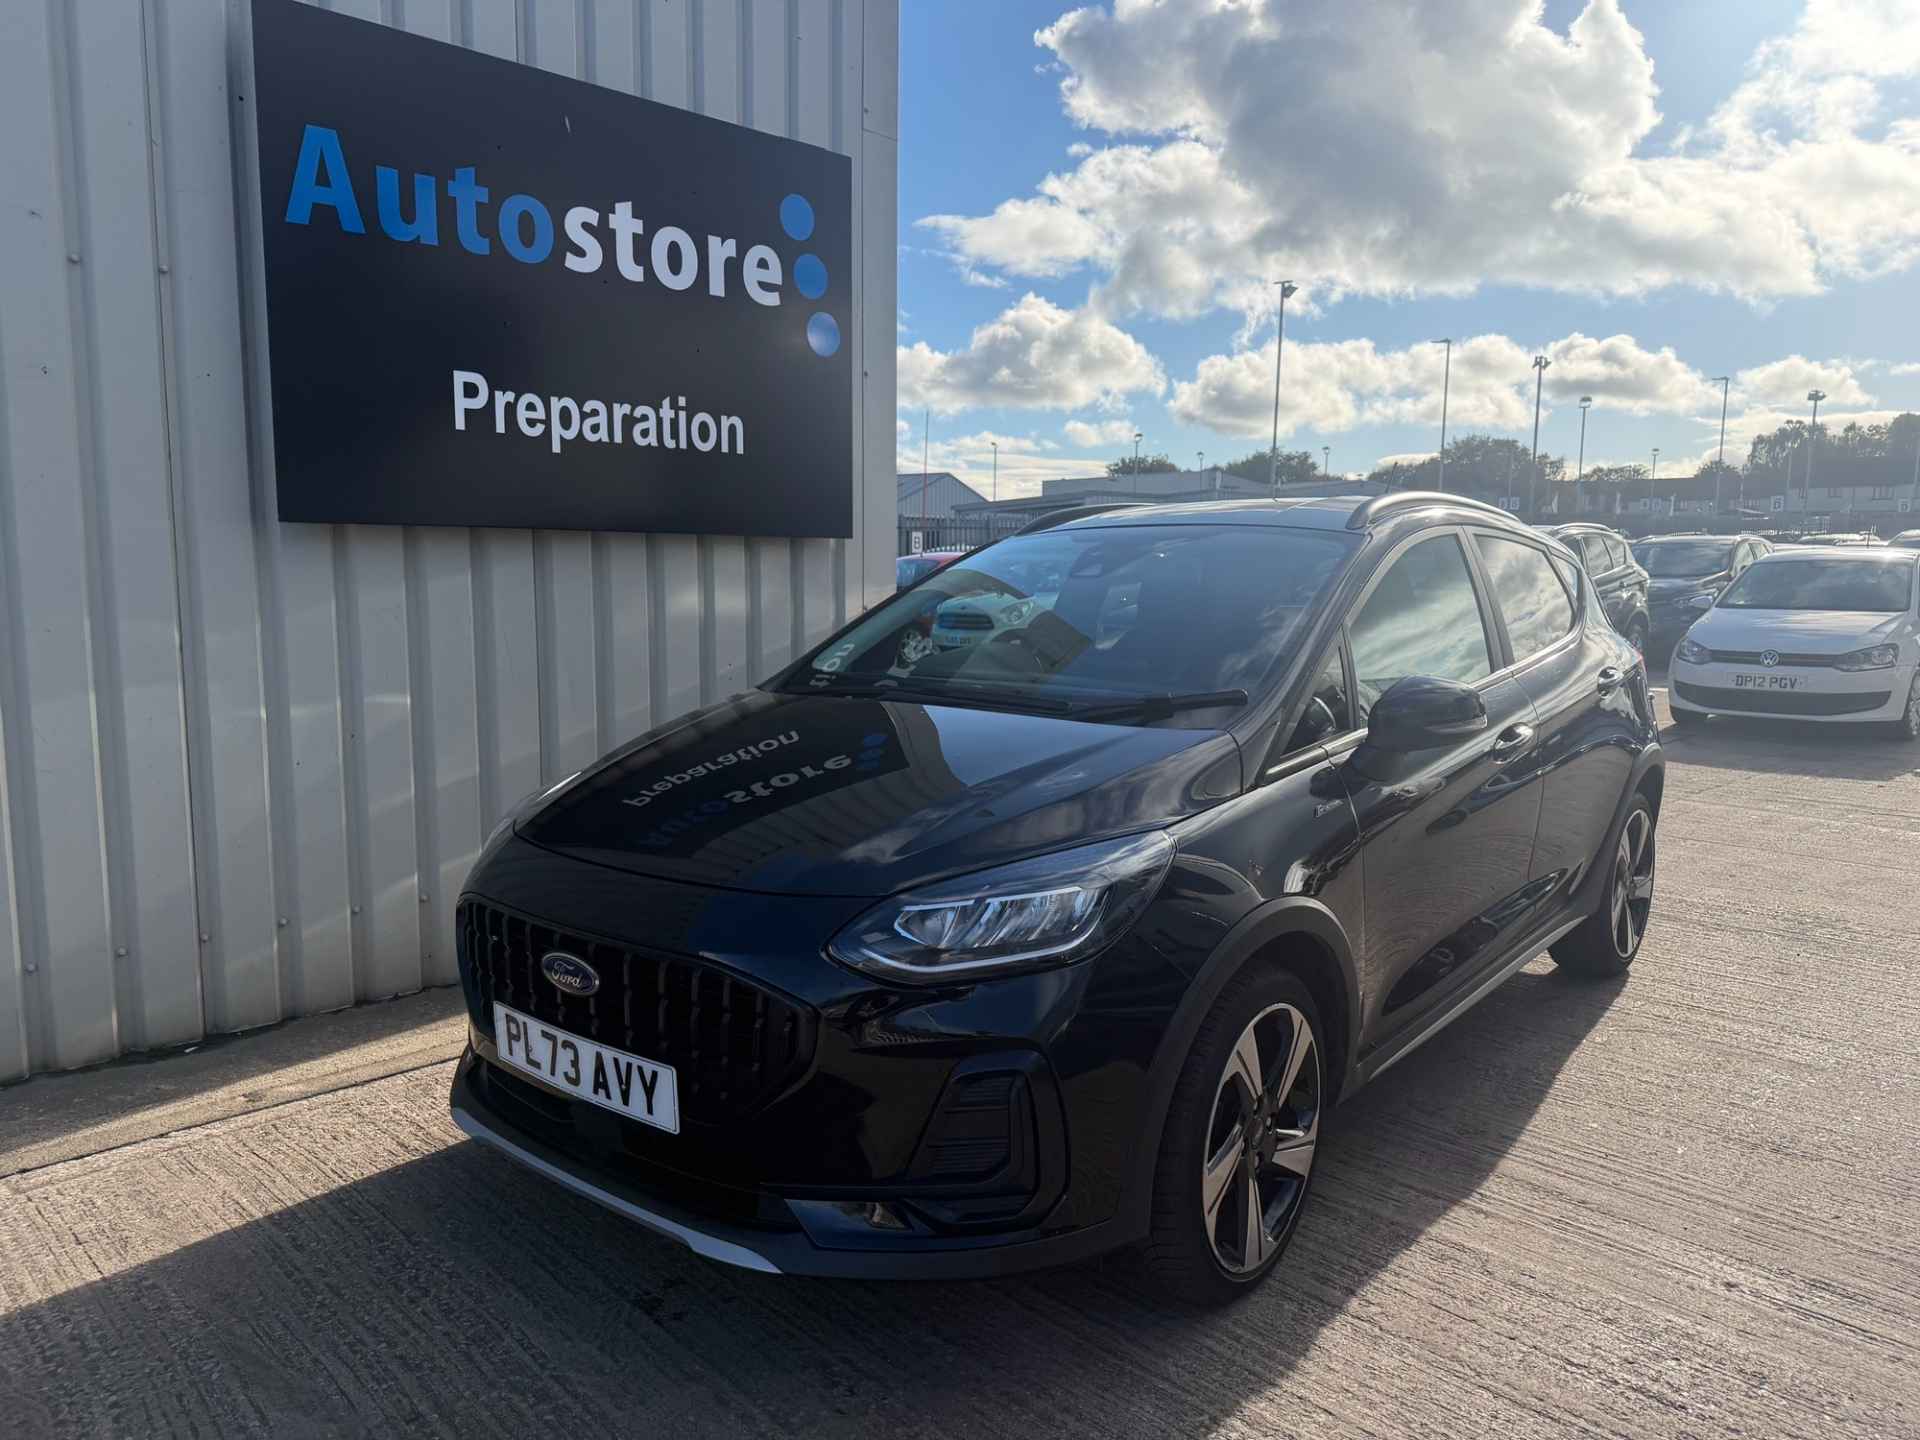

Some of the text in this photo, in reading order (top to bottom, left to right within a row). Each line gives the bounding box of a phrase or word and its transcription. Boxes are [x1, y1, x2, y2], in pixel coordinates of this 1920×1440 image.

[285, 124, 783, 306] Autostore
[453, 370, 744, 454] Preparation
[1773, 501, 1781, 510] D
[914, 536, 921, 549] B
[1735, 675, 1797, 689] DP12 PGV
[551, 960, 583, 988] Ford
[505, 1013, 659, 1116] PL73 AVY
